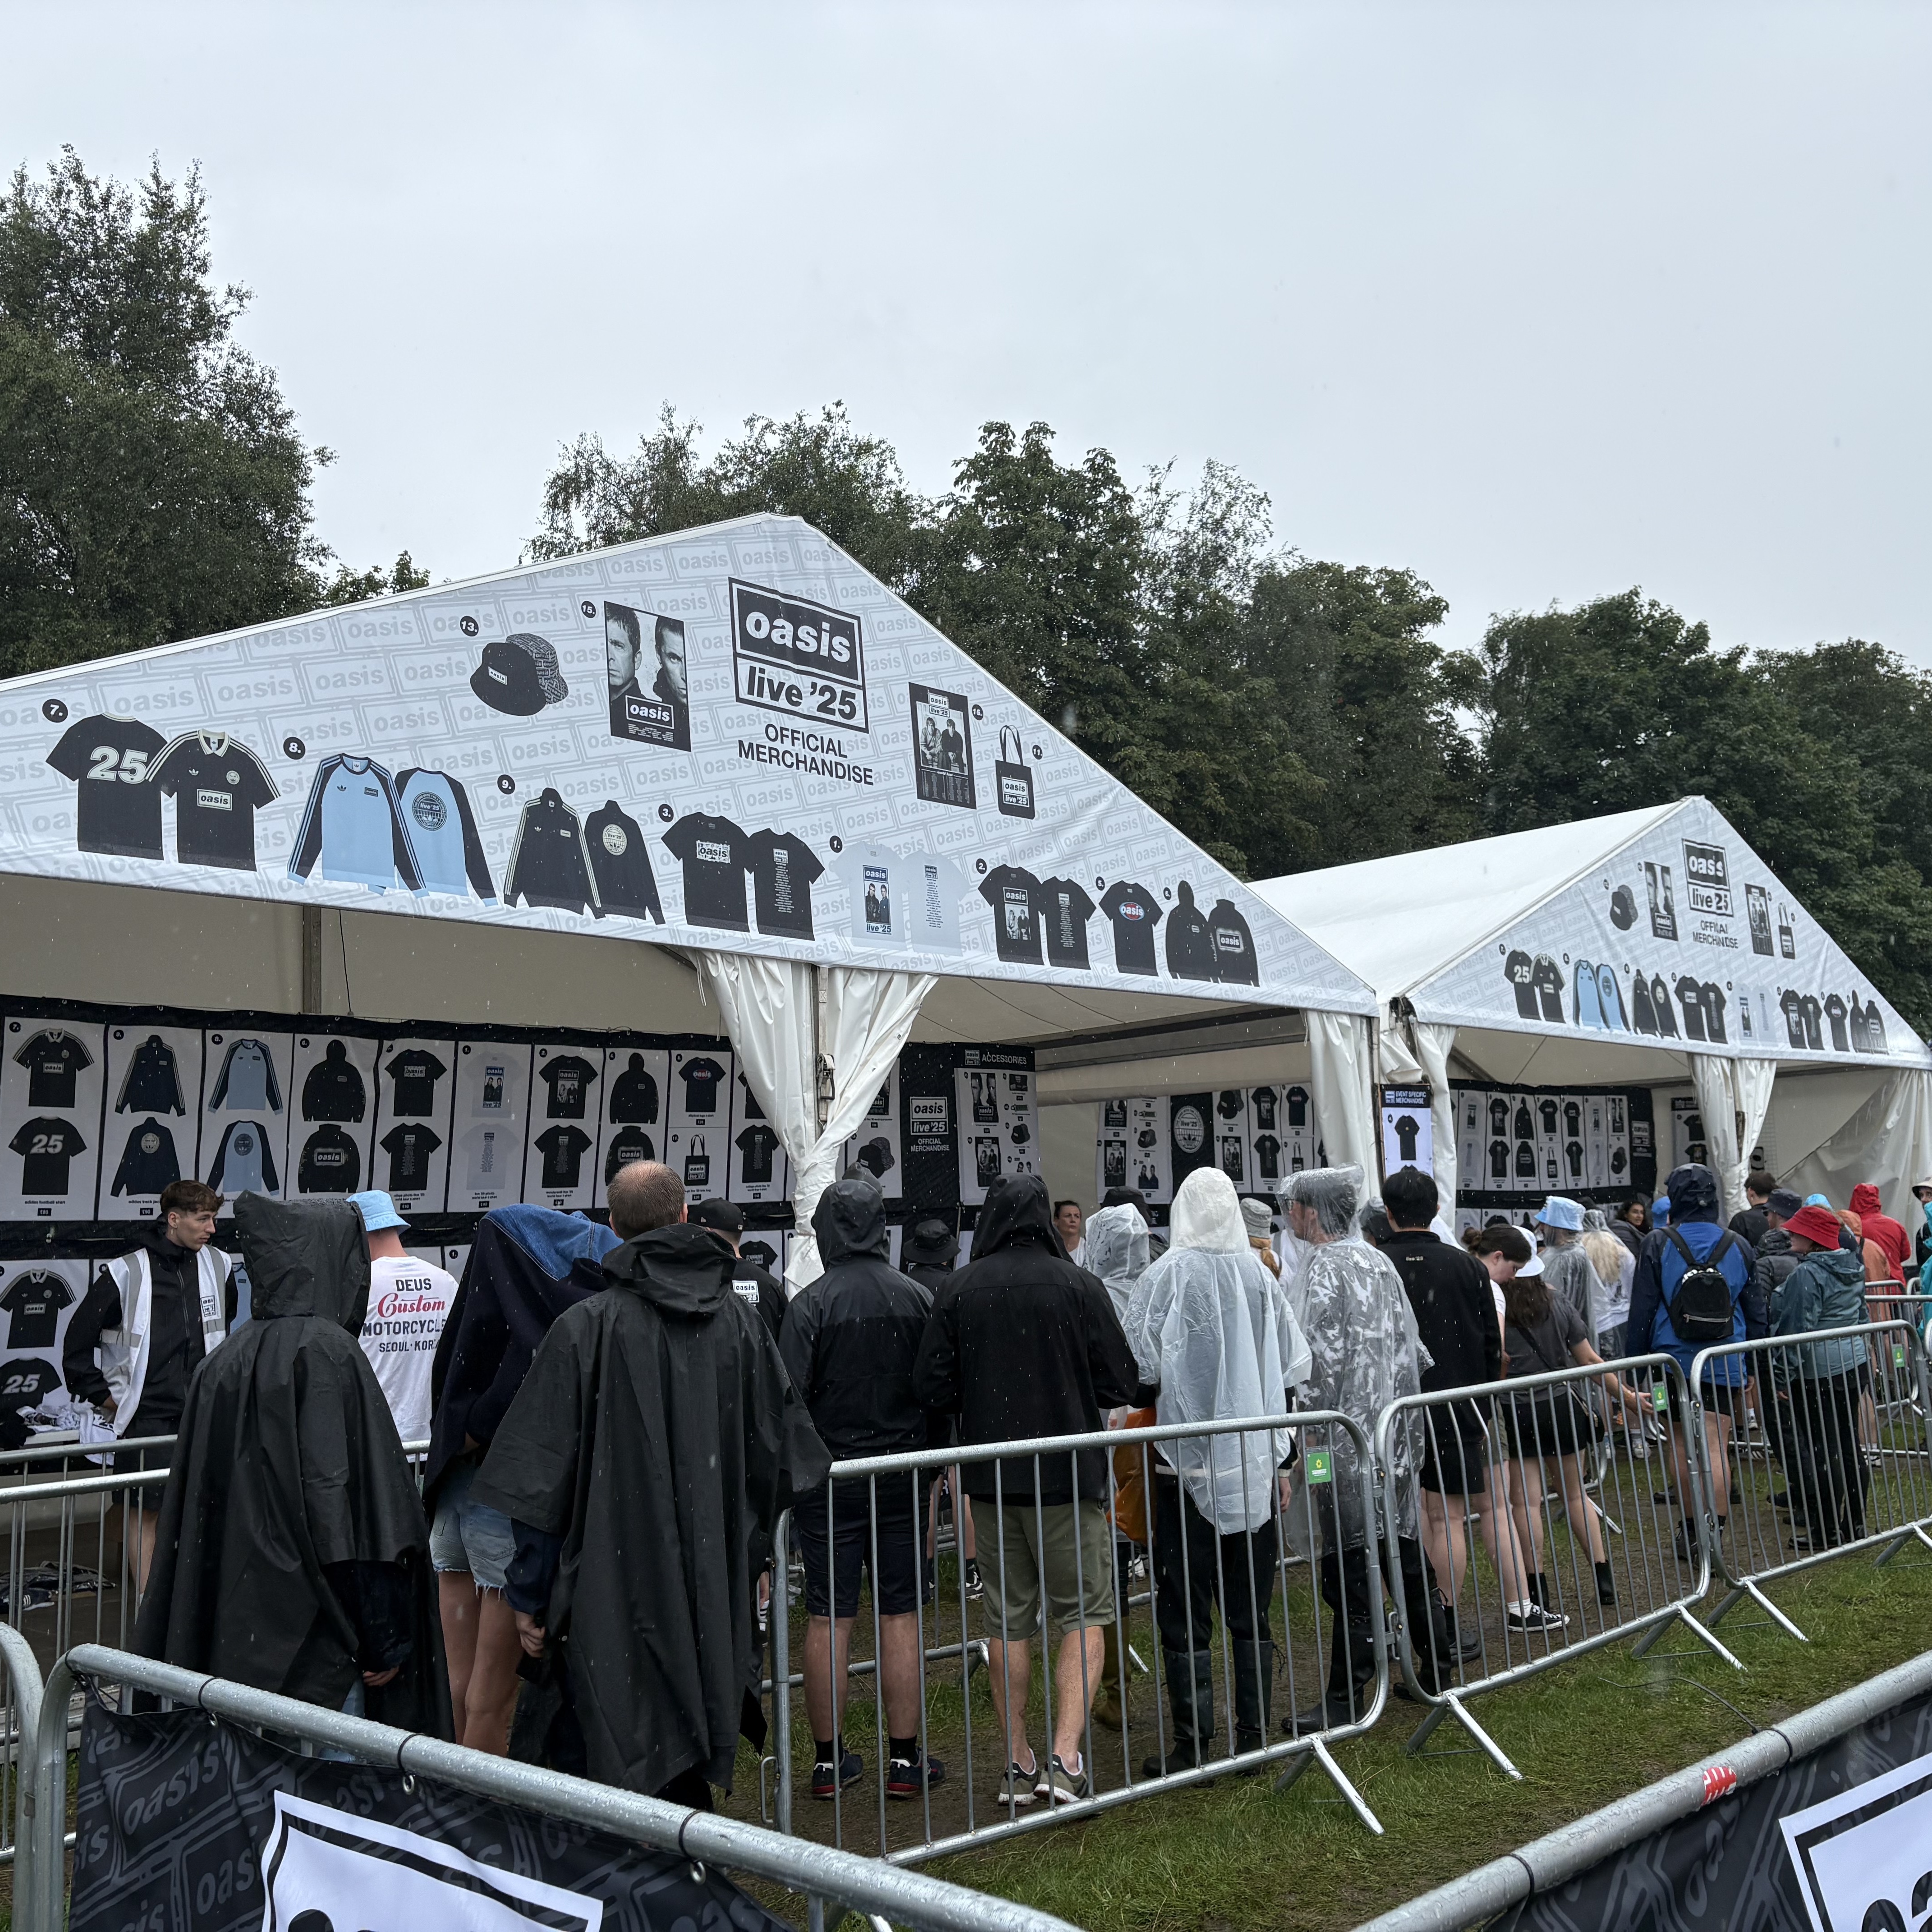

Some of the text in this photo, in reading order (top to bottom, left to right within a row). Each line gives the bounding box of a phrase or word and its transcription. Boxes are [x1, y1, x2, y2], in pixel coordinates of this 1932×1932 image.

[611, 555, 663, 574] oasis
[679, 550, 728, 570] oasis
[743, 547, 789, 565] oasis
[840, 581, 881, 599] oasis
[582, 604, 595, 615] 15.
[658, 593, 707, 612] oasis
[433, 609, 495, 632] oais
[513, 603, 570, 625] oasis
[877, 614, 917, 632] oasis
[348, 616, 413, 639] oasis
[461, 620, 478, 633] 13.
[746, 611, 851, 662] oasis
[913, 646, 950, 664] oasis
[316, 665, 384, 690] oasis
[404, 656, 466, 681] oasis
[490, 671, 505, 681] oasis
[218, 675, 293, 702] oasis
[747, 665, 857, 720] live '25
[114, 686, 194, 713] oasis
[931, 697, 947, 706] oasis
[0, 700, 86, 726] oas
[50, 704, 64, 716] 7.
[374, 707, 440, 731] oasis
[630, 705, 670, 722] oasis
[725, 709, 772, 730] oasis
[973, 709, 982, 717] 16.
[982, 708, 1017, 726] oasis
[289, 742, 301, 754] 8.
[512, 736, 570, 760] oasis
[765, 724, 848, 759] OFFICIAL
[431, 746, 493, 769] oasis
[1033, 748, 1042, 756] 11.
[87, 745, 148, 784] 25
[738, 740, 874, 786] MERCHANDISE
[1046, 762, 1078, 782] oasis
[636, 763, 688, 785] oasis
[502, 780, 512, 790] 9.
[564, 773, 619, 797] oasis
[1005, 782, 1026, 792] oasis
[201, 794, 229, 805] oasis
[746, 785, 794, 807] oasis
[1005, 795, 1016, 803] live
[1077, 790, 1110, 809] oasis
[662, 809, 671, 817] 3.
[847, 807, 888, 828] oasis
[936, 824, 974, 845] oasis
[1107, 817, 1138, 836] oasis
[833, 840, 840, 849] 1.
[1064, 828, 1097, 847] oasis
[700, 847, 727, 858] oasis
[1019, 841, 1054, 860] oasis
[1136, 842, 1166, 862] oasis
[978, 862, 986, 871] 2.
[1094, 854, 1126, 874] oasis
[866, 870, 886, 880] oasis
[1006, 892, 1026, 901] oasis
[1692, 888, 1712, 908] live
[1121, 905, 1144, 917] oasis
[867, 923, 891, 934] live '25
[1221, 936, 1240, 946] oasis
[1270, 962, 1297, 982] oasis
[1514, 965, 1530, 984] 25
[982, 1053, 1027, 1065] ACCESSORIES
[914, 1102, 943, 1114] oasis
[913, 1122, 929, 1133] live
[30, 1134, 64, 1155] 25
[395, 1278, 431, 1292] DEUS
[377, 1293, 445, 1318] Custom
[2, 1374, 41, 1394] 25
[124, 1741, 219, 1835] oasis
